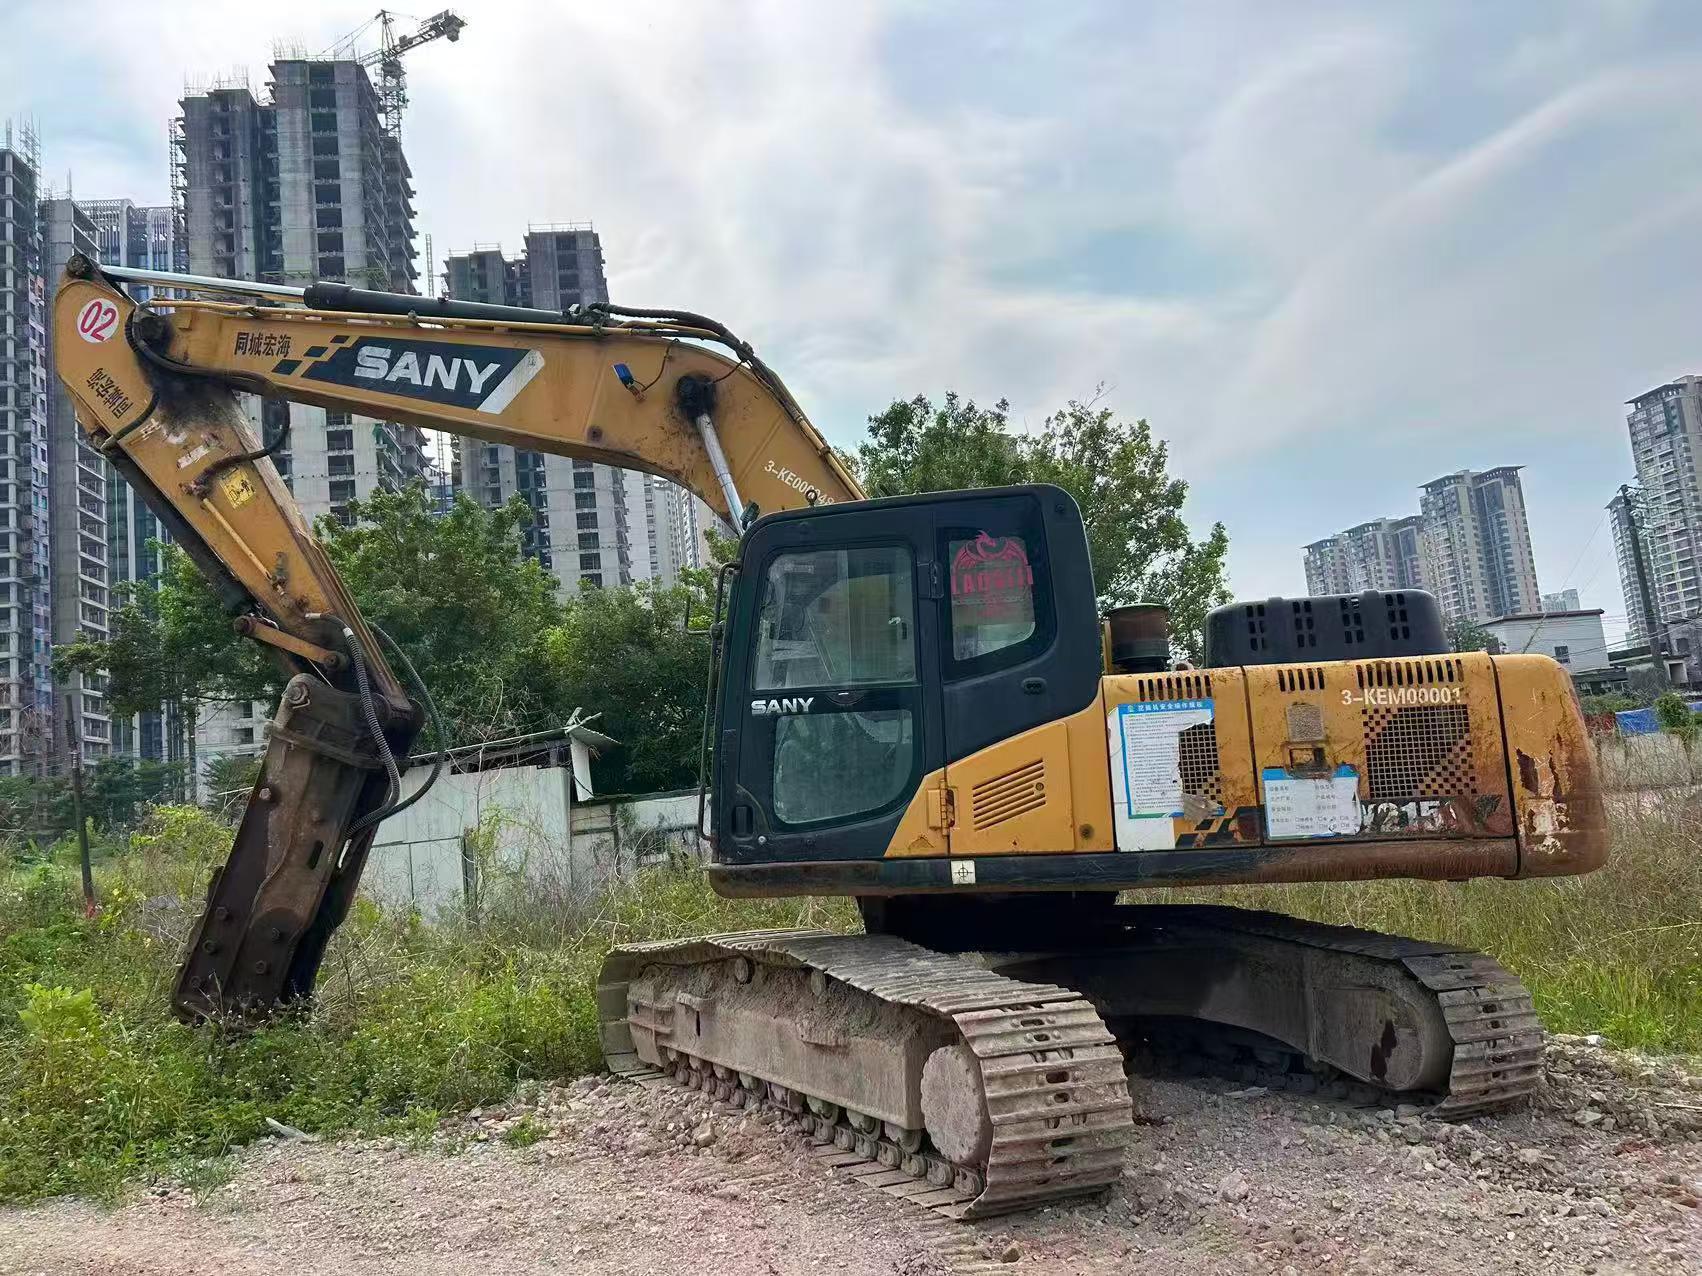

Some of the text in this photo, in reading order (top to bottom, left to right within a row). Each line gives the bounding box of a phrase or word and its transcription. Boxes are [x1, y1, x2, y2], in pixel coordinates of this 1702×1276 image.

[80, 301, 117, 341] 02
[234, 332, 291, 358] 同城宏海
[353, 345, 501, 394] SANY
[751, 697, 814, 715] SANY
[1341, 687, 1462, 705] 3-KEM00001
